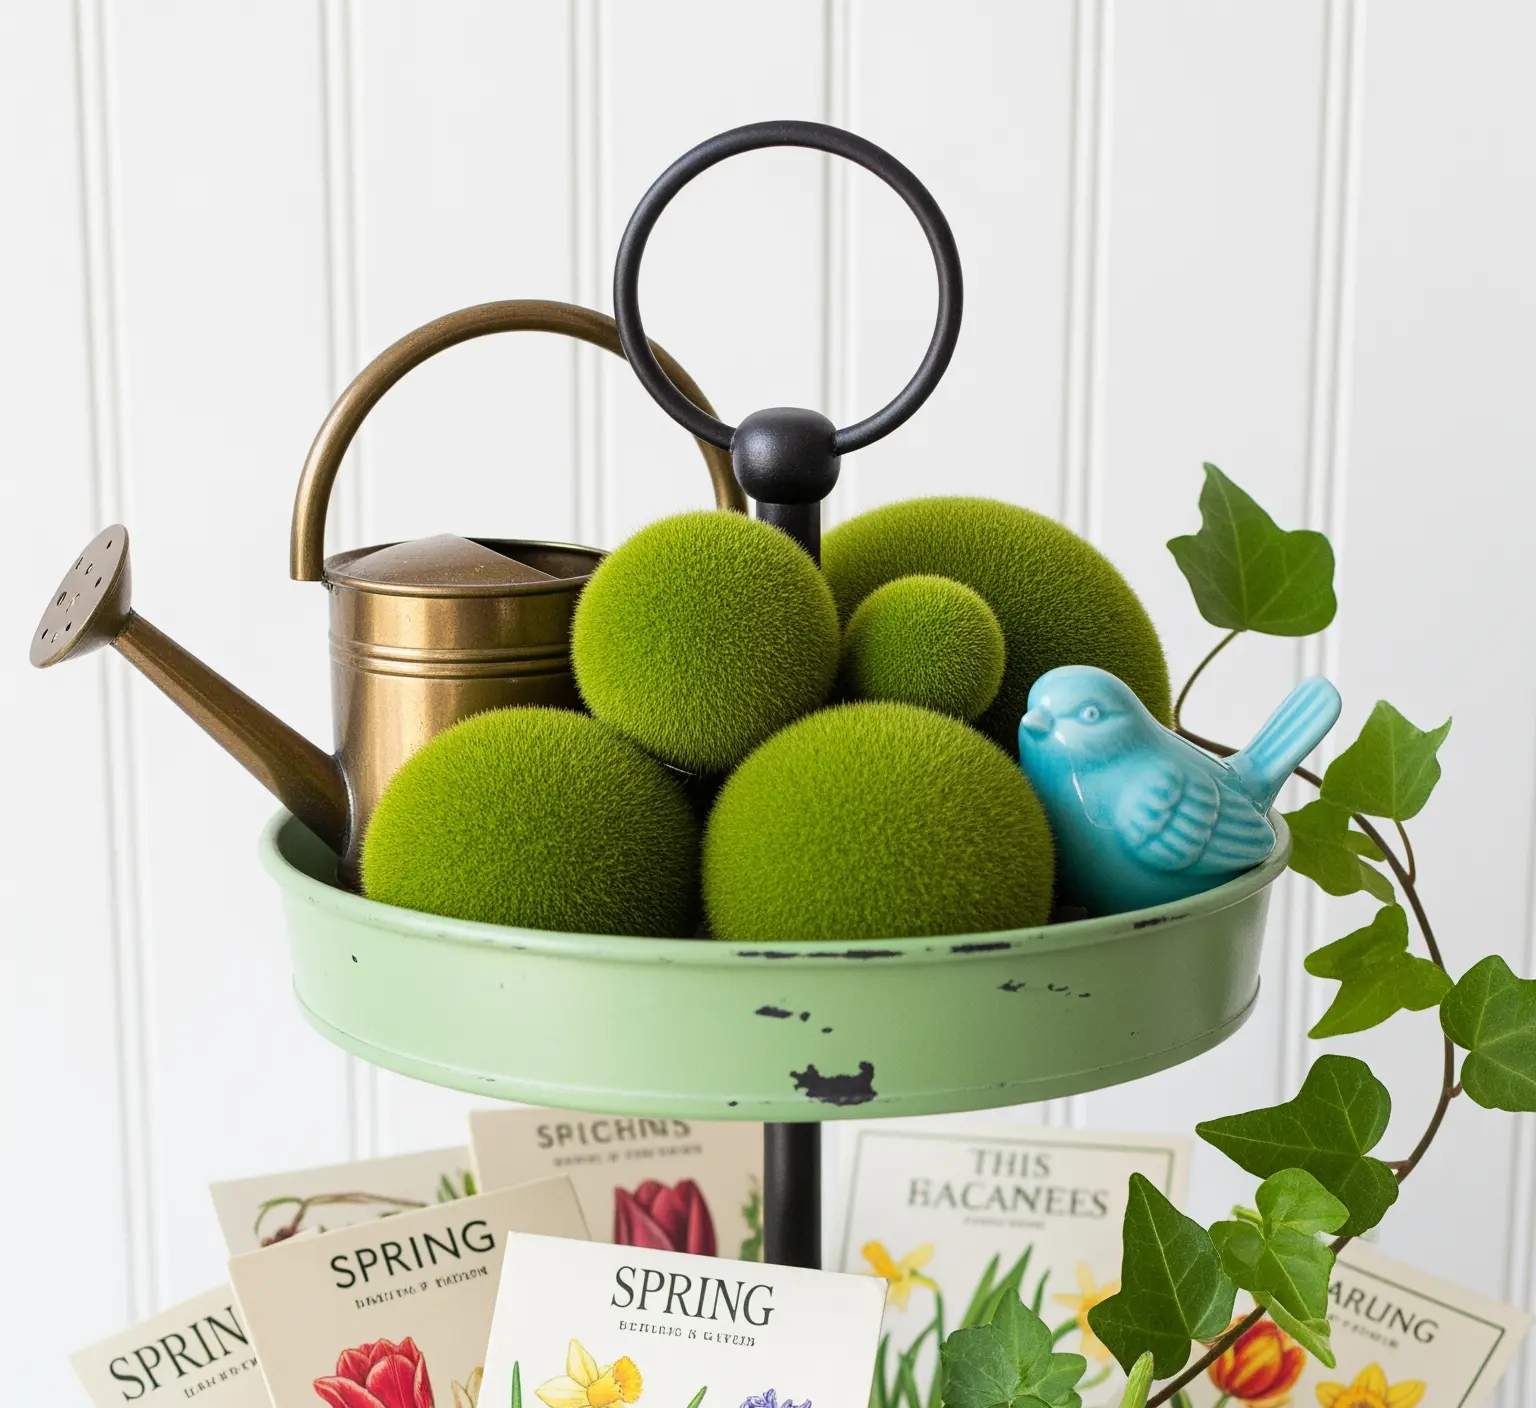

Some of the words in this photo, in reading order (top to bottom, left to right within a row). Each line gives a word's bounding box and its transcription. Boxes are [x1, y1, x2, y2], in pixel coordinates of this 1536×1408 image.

[968, 1149, 1052, 1178] THIS
[330, 1220, 496, 1289] SPRING
[611, 1265, 775, 1326] SPRING
[1328, 1280, 1440, 1344] ARUNG
[109, 1305, 249, 1403] SPRIN
